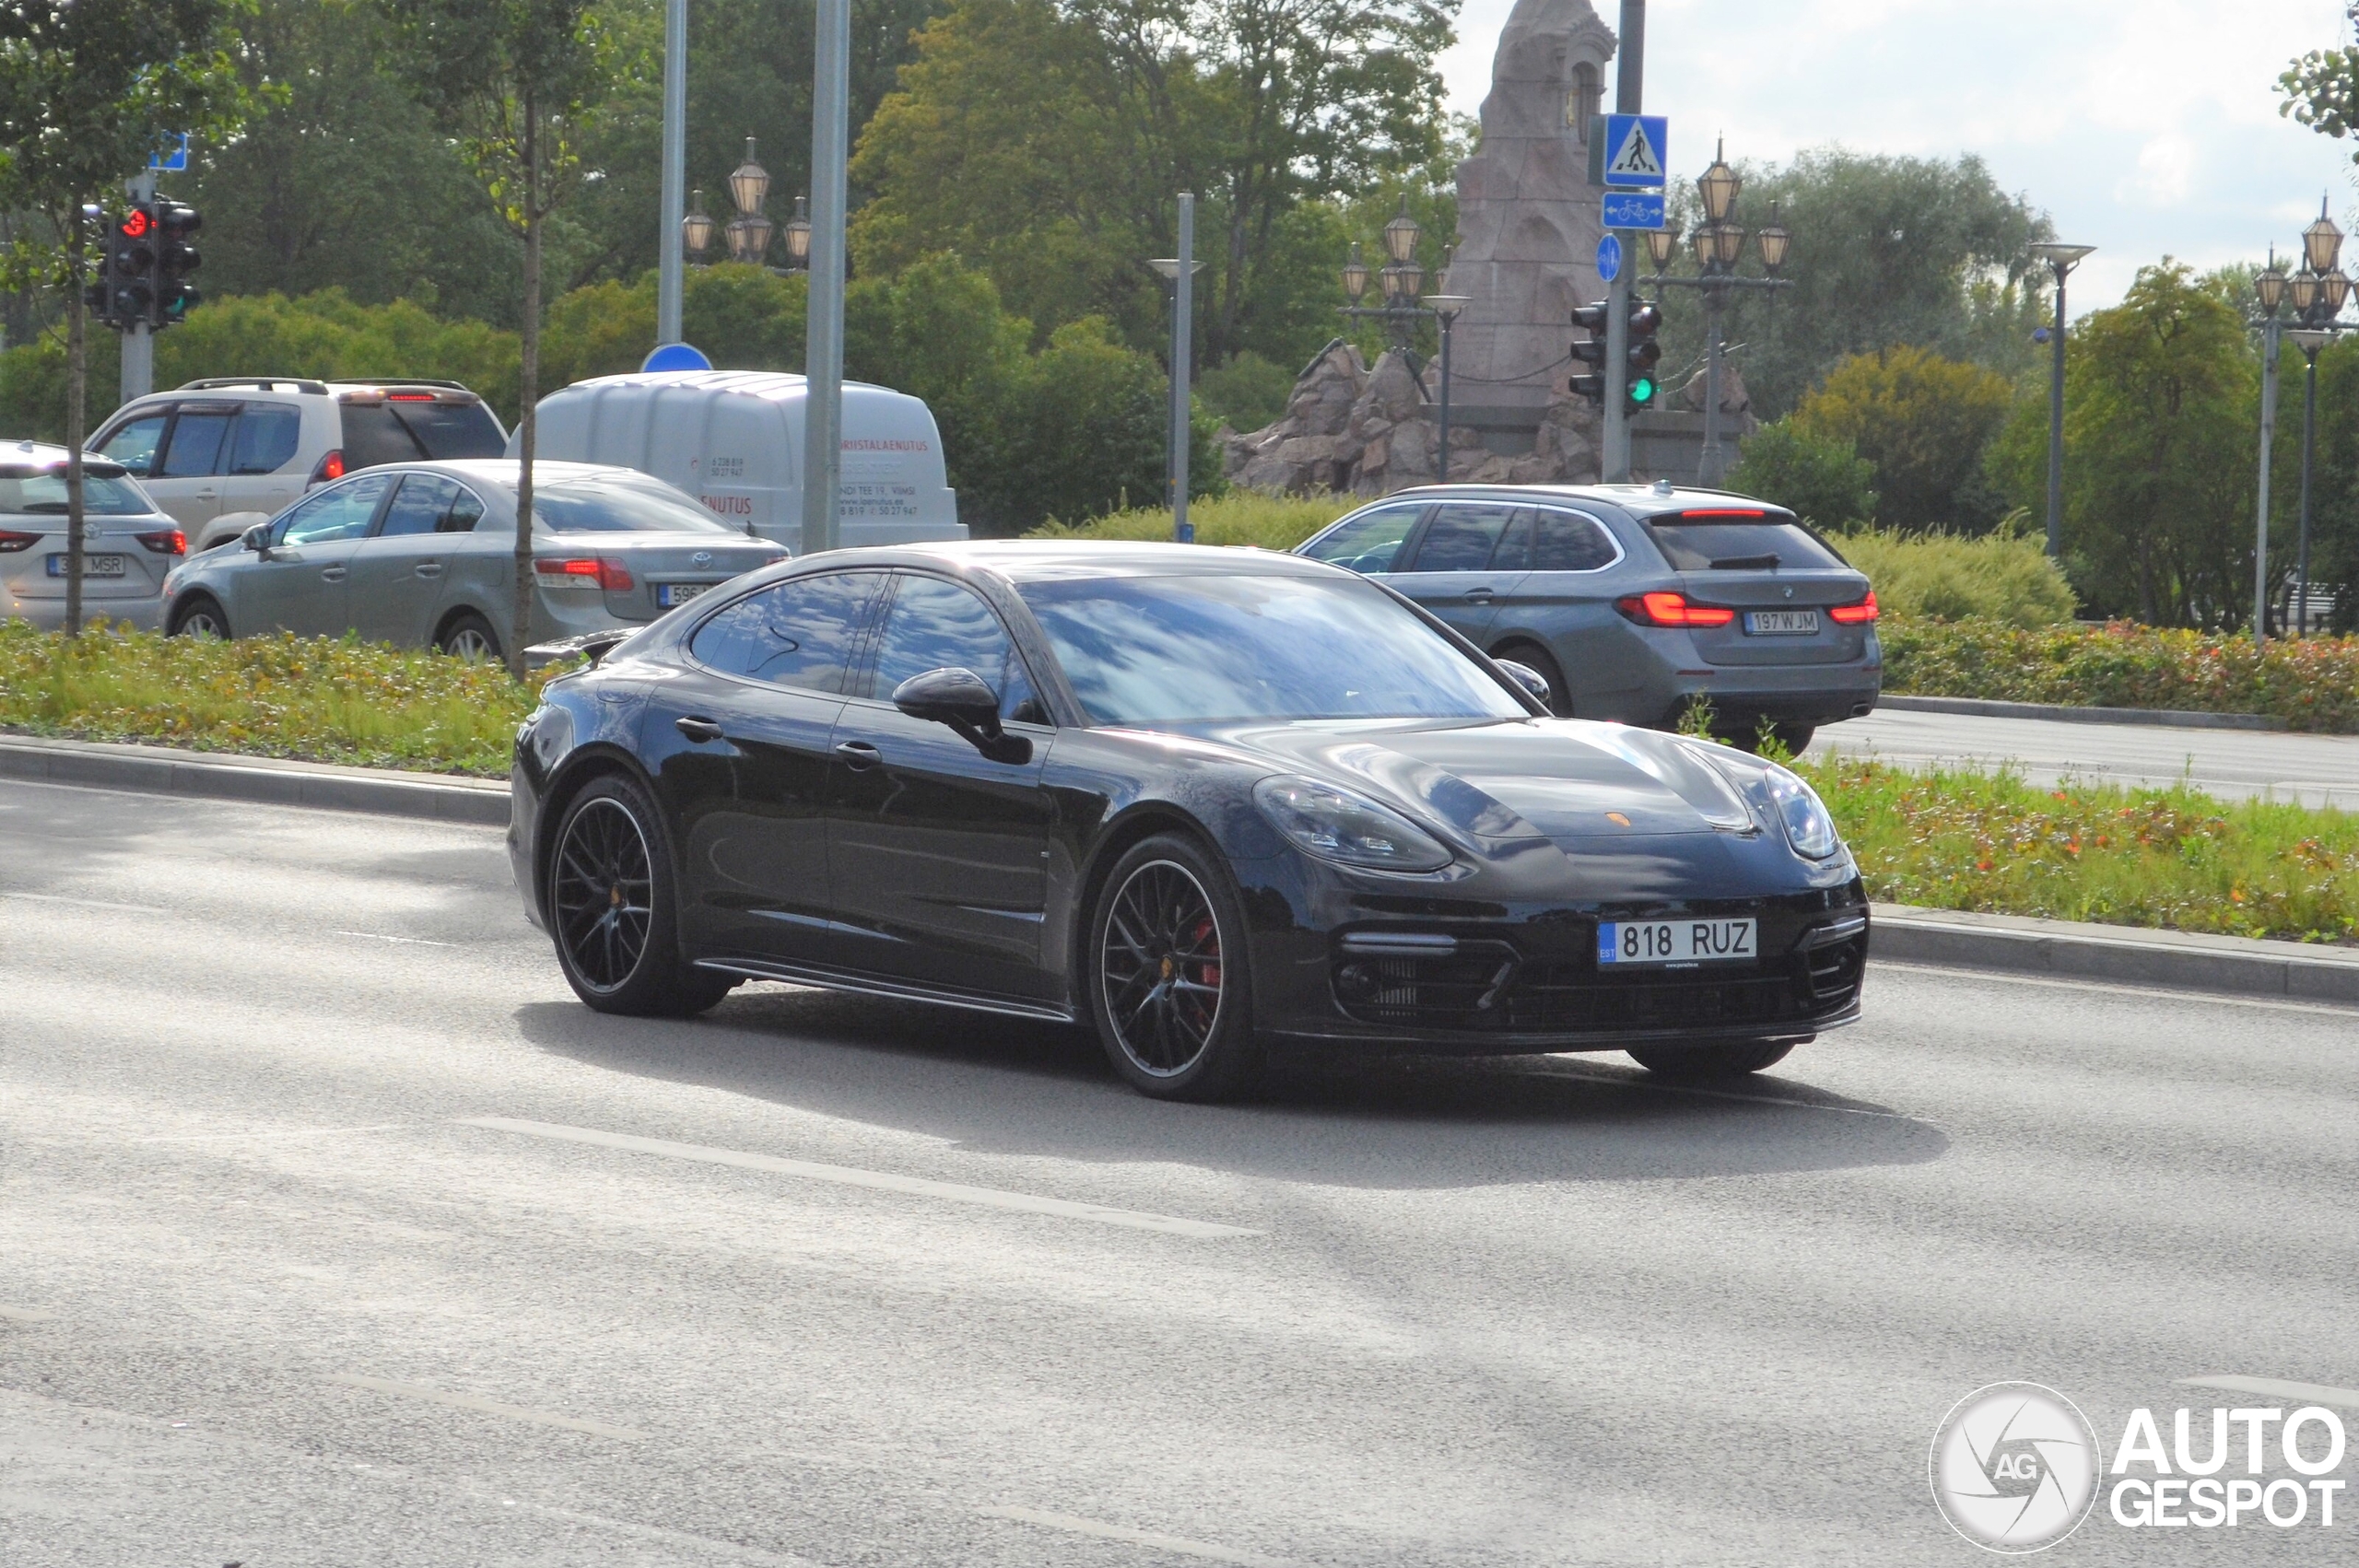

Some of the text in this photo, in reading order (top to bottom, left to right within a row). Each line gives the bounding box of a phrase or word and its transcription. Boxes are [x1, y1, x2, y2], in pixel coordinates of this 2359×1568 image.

[858, 486, 873, 496] TEE
[849, 507, 865, 516] 819
[91, 557, 121, 572] MSR
[1755, 613, 1778, 629] 197
[1624, 922, 1749, 957] 818 RUZ
[1600, 948, 1615, 959] EST
